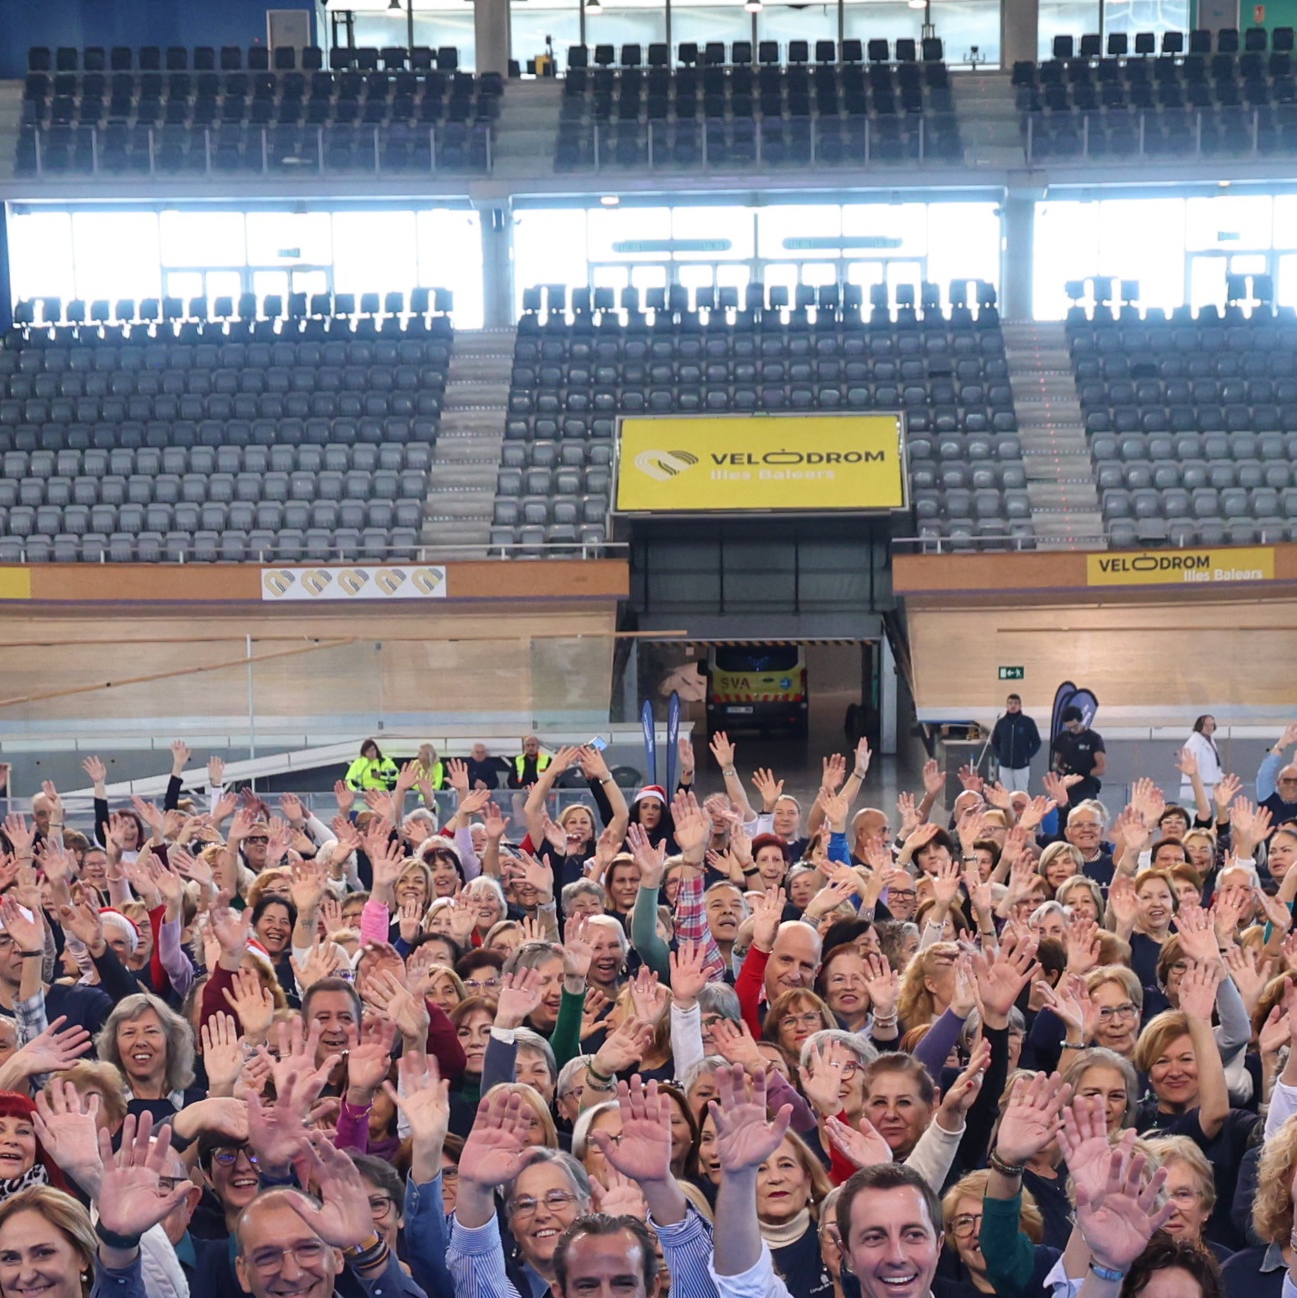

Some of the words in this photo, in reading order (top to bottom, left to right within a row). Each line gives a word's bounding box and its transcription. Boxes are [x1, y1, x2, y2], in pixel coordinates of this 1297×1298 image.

[710, 469, 752, 481] Illes
[759, 468, 836, 480] Balears
[1184, 569, 1210, 581] Illes
[1214, 568, 1264, 581] Balears
[721, 677, 751, 690] SVA
